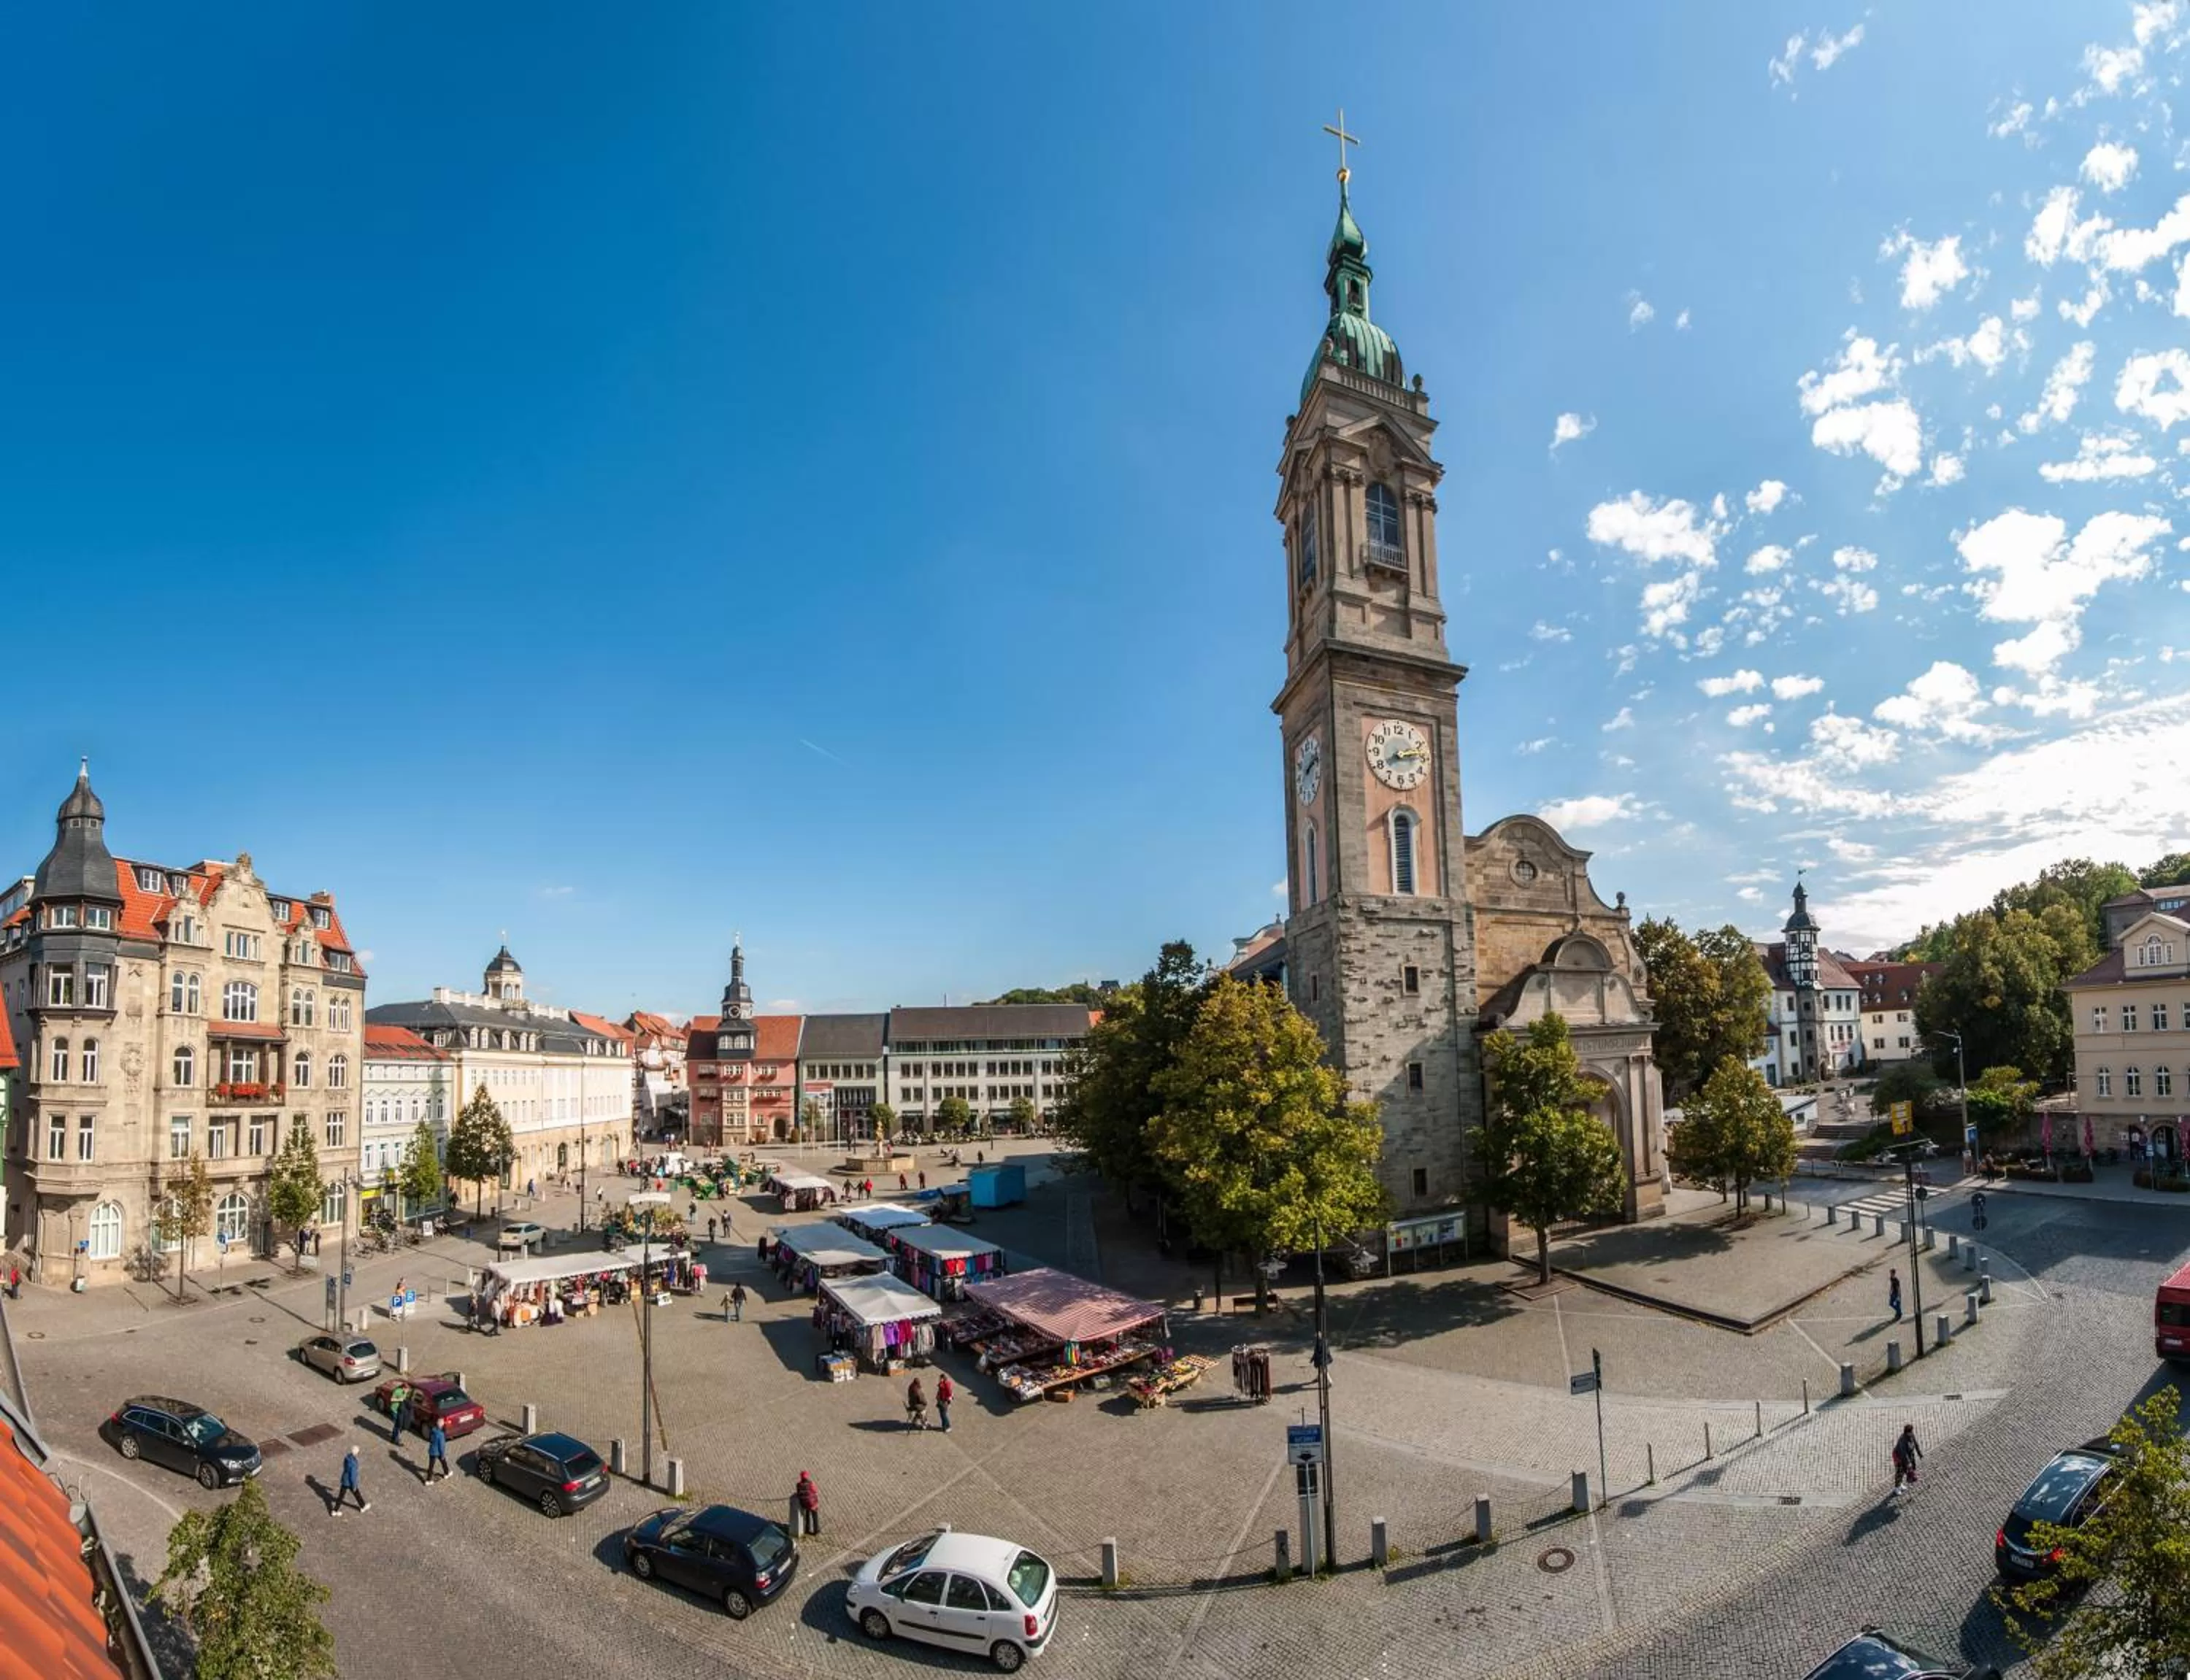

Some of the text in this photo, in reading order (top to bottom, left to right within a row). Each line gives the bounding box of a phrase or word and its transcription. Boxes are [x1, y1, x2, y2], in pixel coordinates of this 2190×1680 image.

[1383, 726, 1391, 736] 11
[1394, 725, 1403, 734] 12
[1374, 735, 1385, 744] 10
[1372, 747, 1380, 757] 9
[1377, 760, 1384, 769] 8
[1416, 766, 1423, 774] 4
[1386, 770, 1392, 780] 7
[1408, 774, 1415, 782] 5
[1397, 775, 1404, 785] 6
[394, 1297, 400, 1306] P
